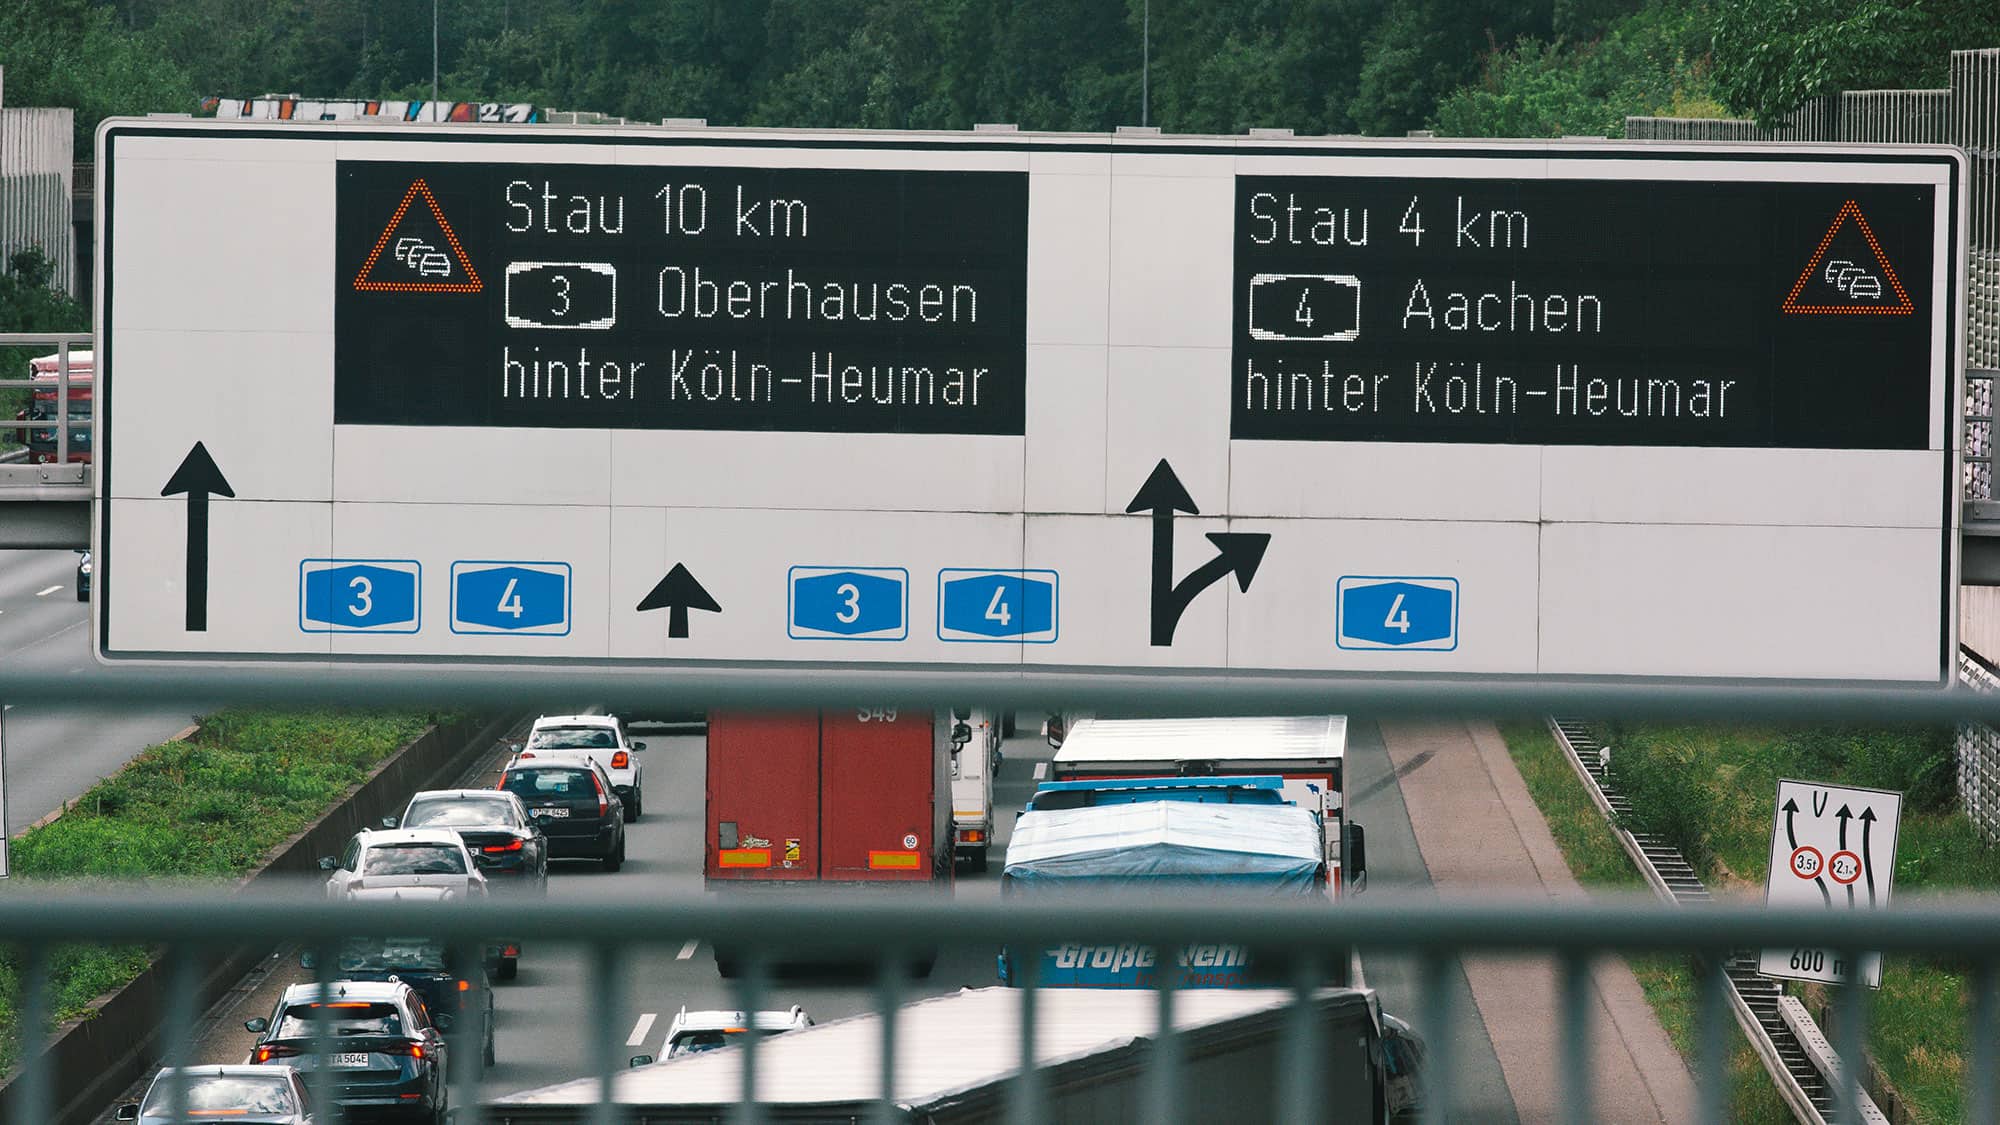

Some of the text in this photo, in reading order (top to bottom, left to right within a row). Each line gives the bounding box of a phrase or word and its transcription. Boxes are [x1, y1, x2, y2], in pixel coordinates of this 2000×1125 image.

[505, 180, 808, 237] Stau 10 km
[1250, 192, 1528, 249] Stau 4 km
[551, 266, 977, 323] 3 Oberhausen
[1295, 278, 1601, 333] 4 Aachen
[503, 346, 990, 406] hinter Köln-Heumar
[1246, 358, 1736, 418] hinter Köln-Heumar
[348, 576, 524, 618] 3 4
[836, 583, 1011, 626] 3 4
[1384, 593, 1410, 633] 4
[1790, 948, 1824, 972] 600
